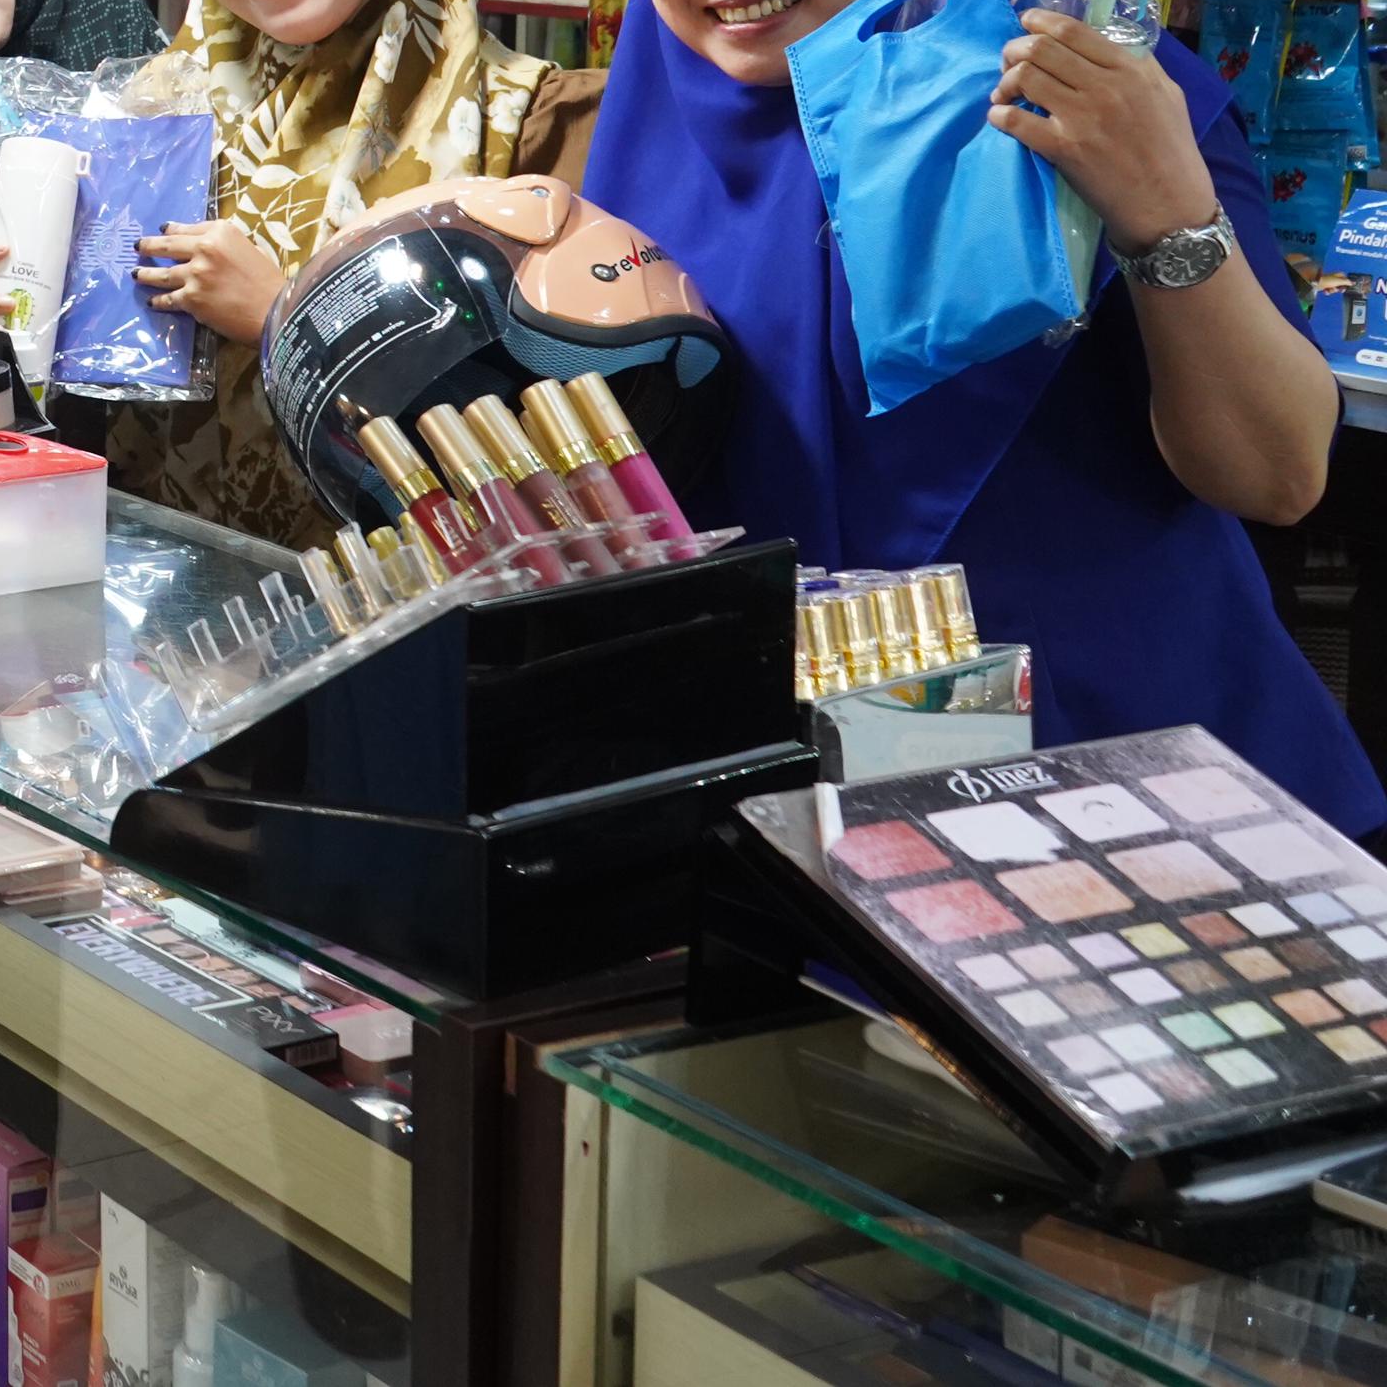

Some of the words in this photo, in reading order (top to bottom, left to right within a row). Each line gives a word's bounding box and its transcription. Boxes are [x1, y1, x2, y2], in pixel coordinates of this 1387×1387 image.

[11, 266, 41, 279] LOVE
[293, 290, 328, 325] PROTECTIVE
[340, 261, 367, 285] BEFORE
[979, 764, 1054, 790] inez
[51, 921, 221, 1007] EVERYWHERE
